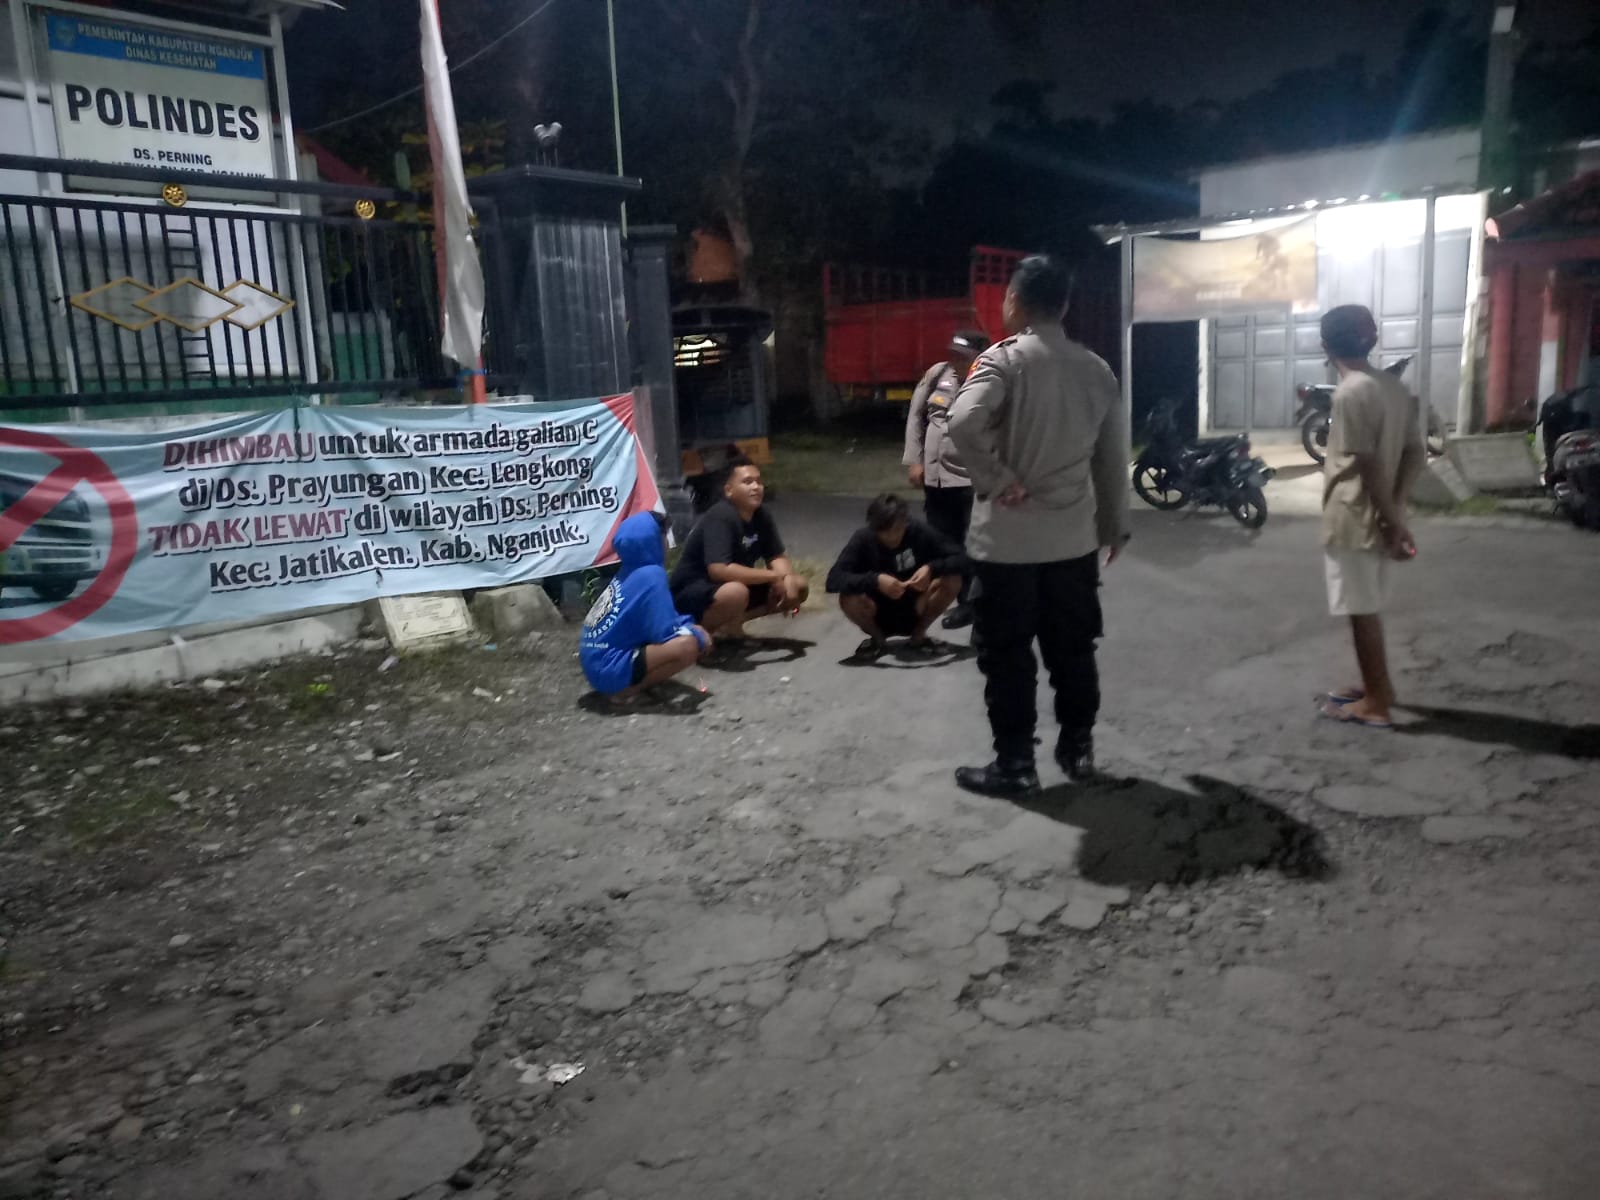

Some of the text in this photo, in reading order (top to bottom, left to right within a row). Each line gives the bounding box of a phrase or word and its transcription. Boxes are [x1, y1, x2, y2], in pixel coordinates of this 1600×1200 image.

[78, 23, 254, 62] PEMERINTAH KABUPATEN NGANJUK
[126, 45, 216, 70] DINAS KESEHATAN
[65, 84, 260, 141] POLINDES
[133, 148, 213, 166] DS. PERNING
[164, 419, 597, 466] DIHIMBAU untuk armada galian C
[178, 455, 593, 507] di Ds. Prayungan Kec. Lengkong
[149, 484, 616, 552] TIDAK LEWAT di wilayah Ds. Perning
[210, 560, 271, 588] Kec.
[422, 533, 481, 562] Kab.
[488, 523, 585, 558] Nganjuk.
